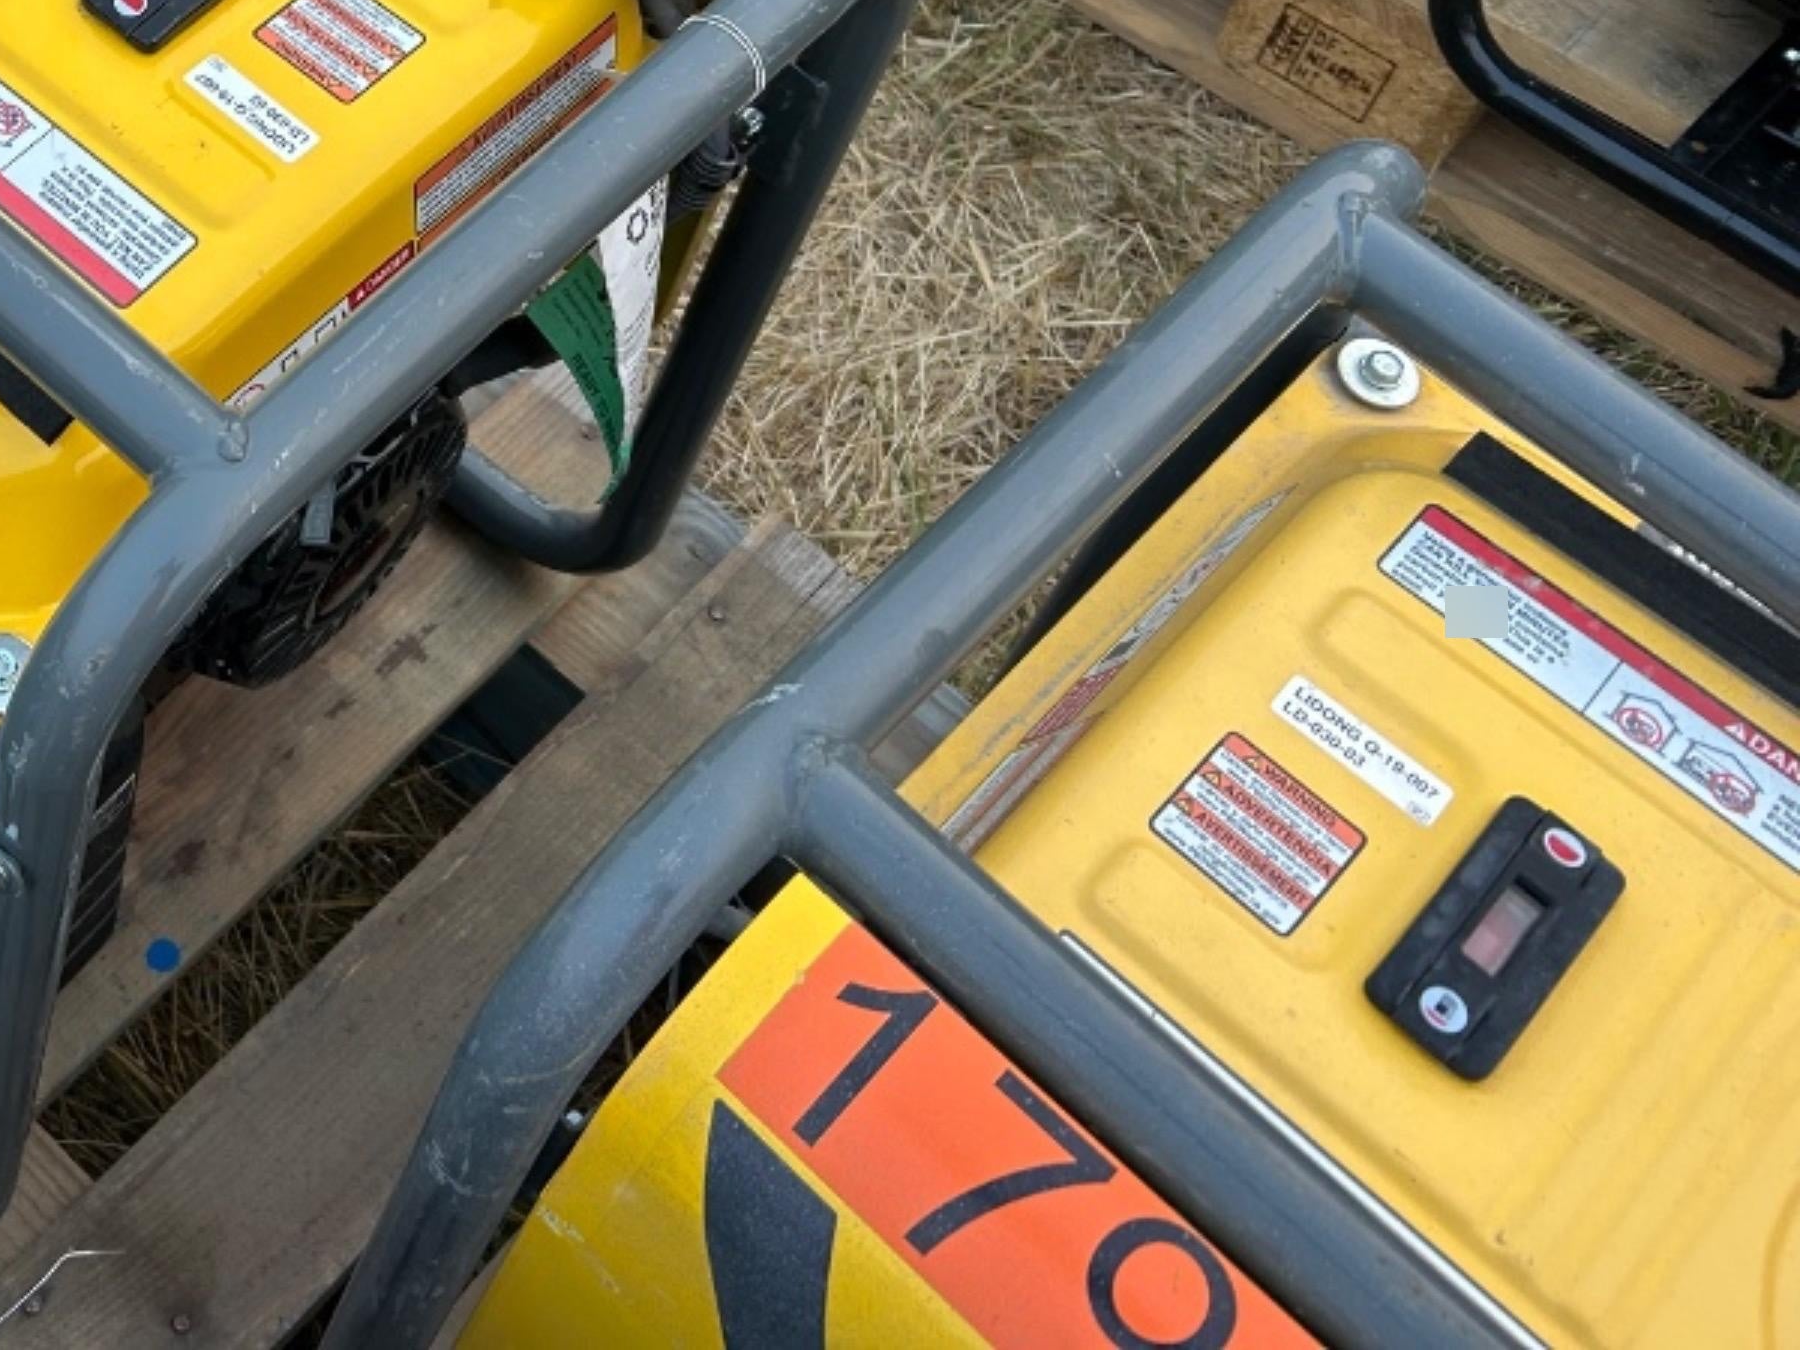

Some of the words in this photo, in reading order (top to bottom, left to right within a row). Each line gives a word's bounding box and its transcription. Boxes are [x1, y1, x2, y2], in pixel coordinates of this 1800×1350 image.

[1290, 684, 1366, 744] LIDONG
[1217, 781, 1340, 877] ADVERTENCIA
[1258, 762, 1342, 829] WARNING
